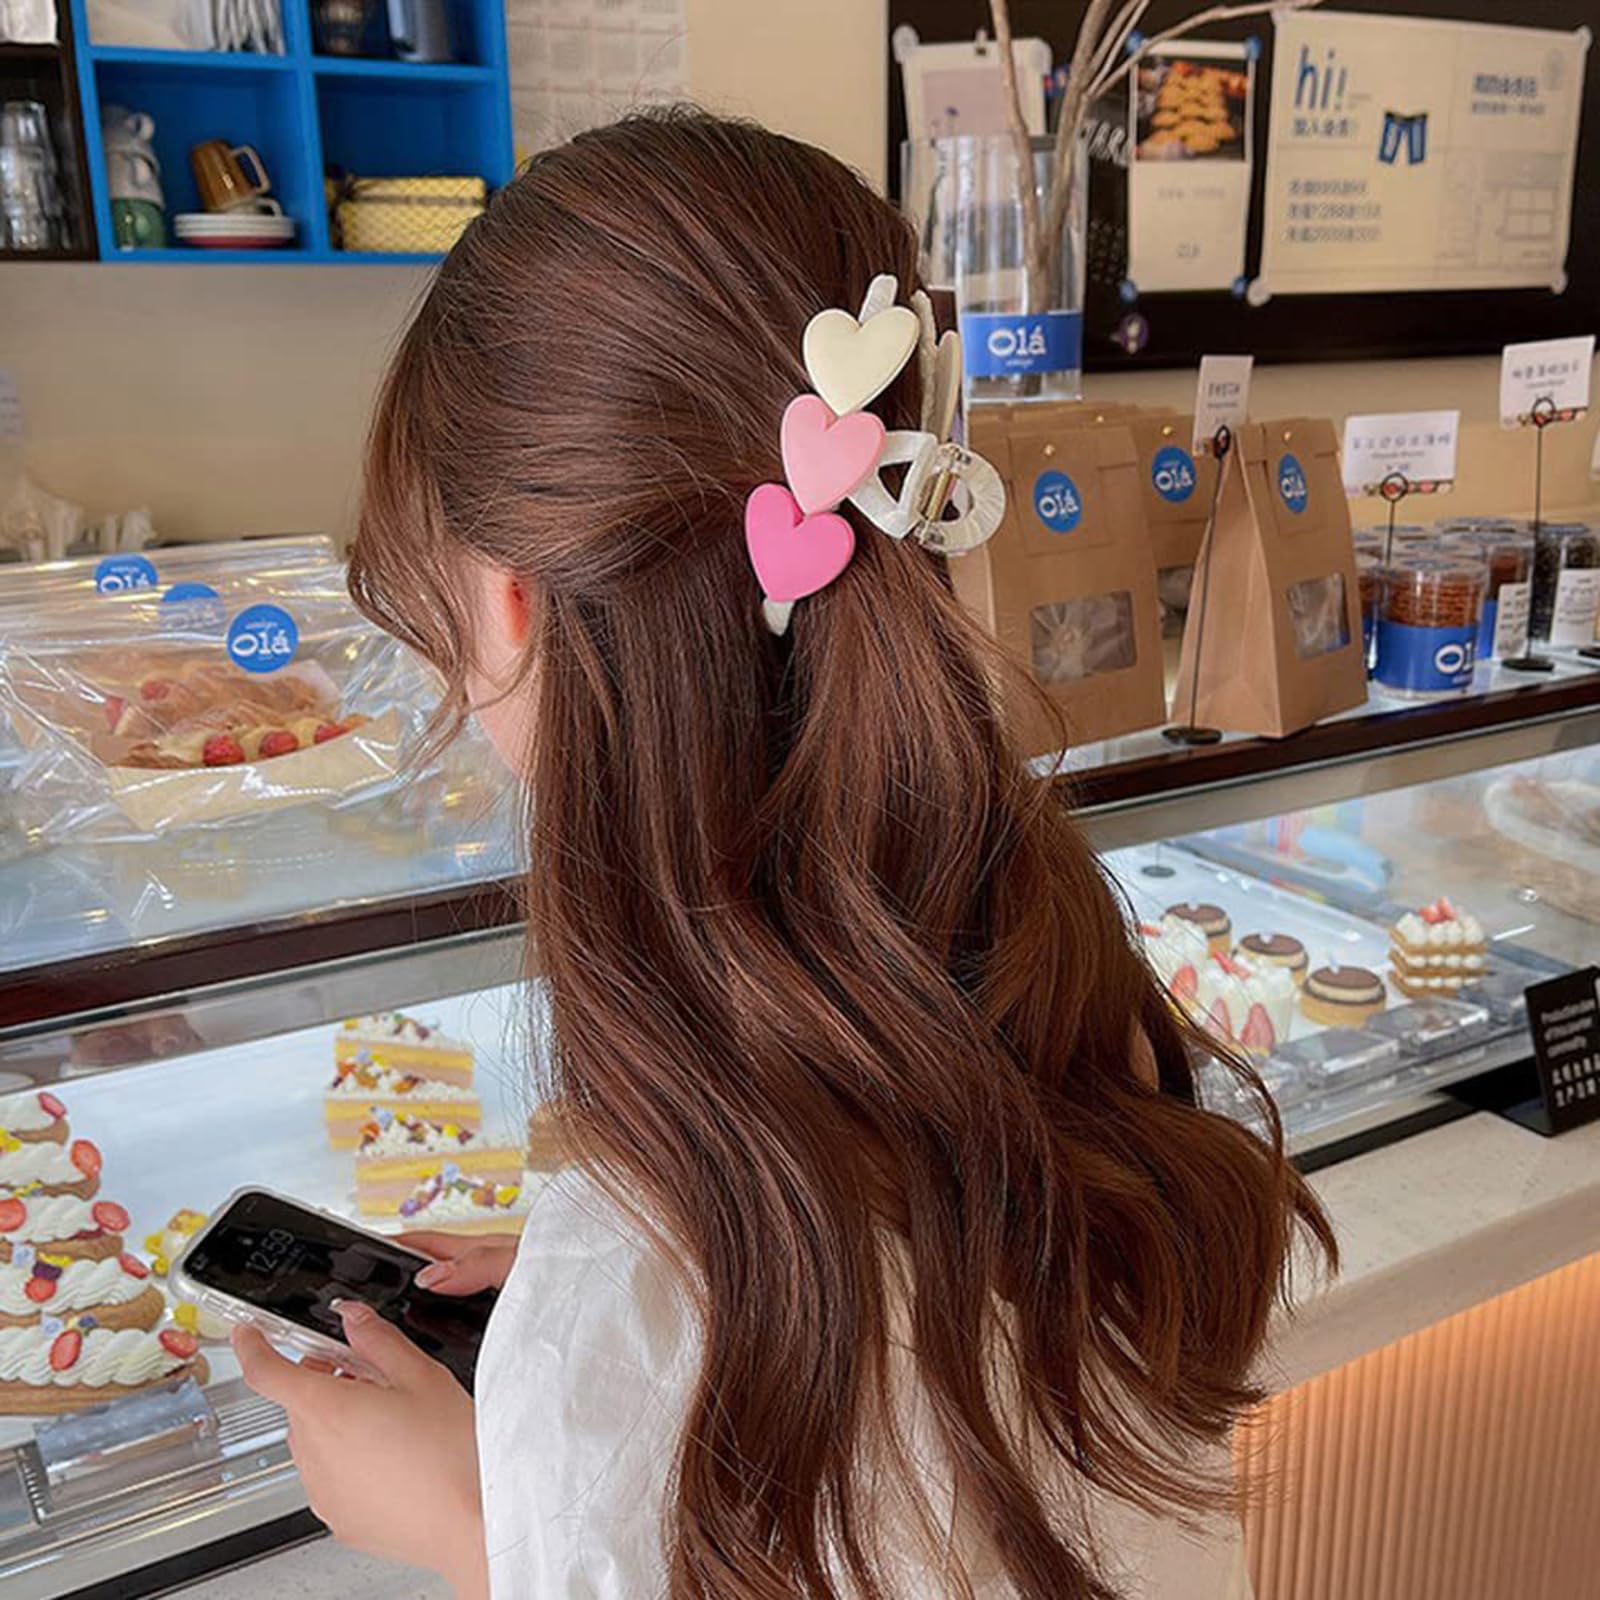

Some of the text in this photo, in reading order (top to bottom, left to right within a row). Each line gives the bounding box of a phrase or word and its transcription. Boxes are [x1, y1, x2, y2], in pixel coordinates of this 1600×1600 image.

[1294, 43, 1347, 110] hi!
[987, 325, 1046, 357] Olá
[1155, 464, 1193, 491] Olá
[1280, 474, 1306, 499] Olá
[1039, 488, 1079, 518] Olá
[231, 629, 292, 657] Olá
[1434, 641, 1473, 674] Ol
[246, 1229, 294, 1272] 12:59
